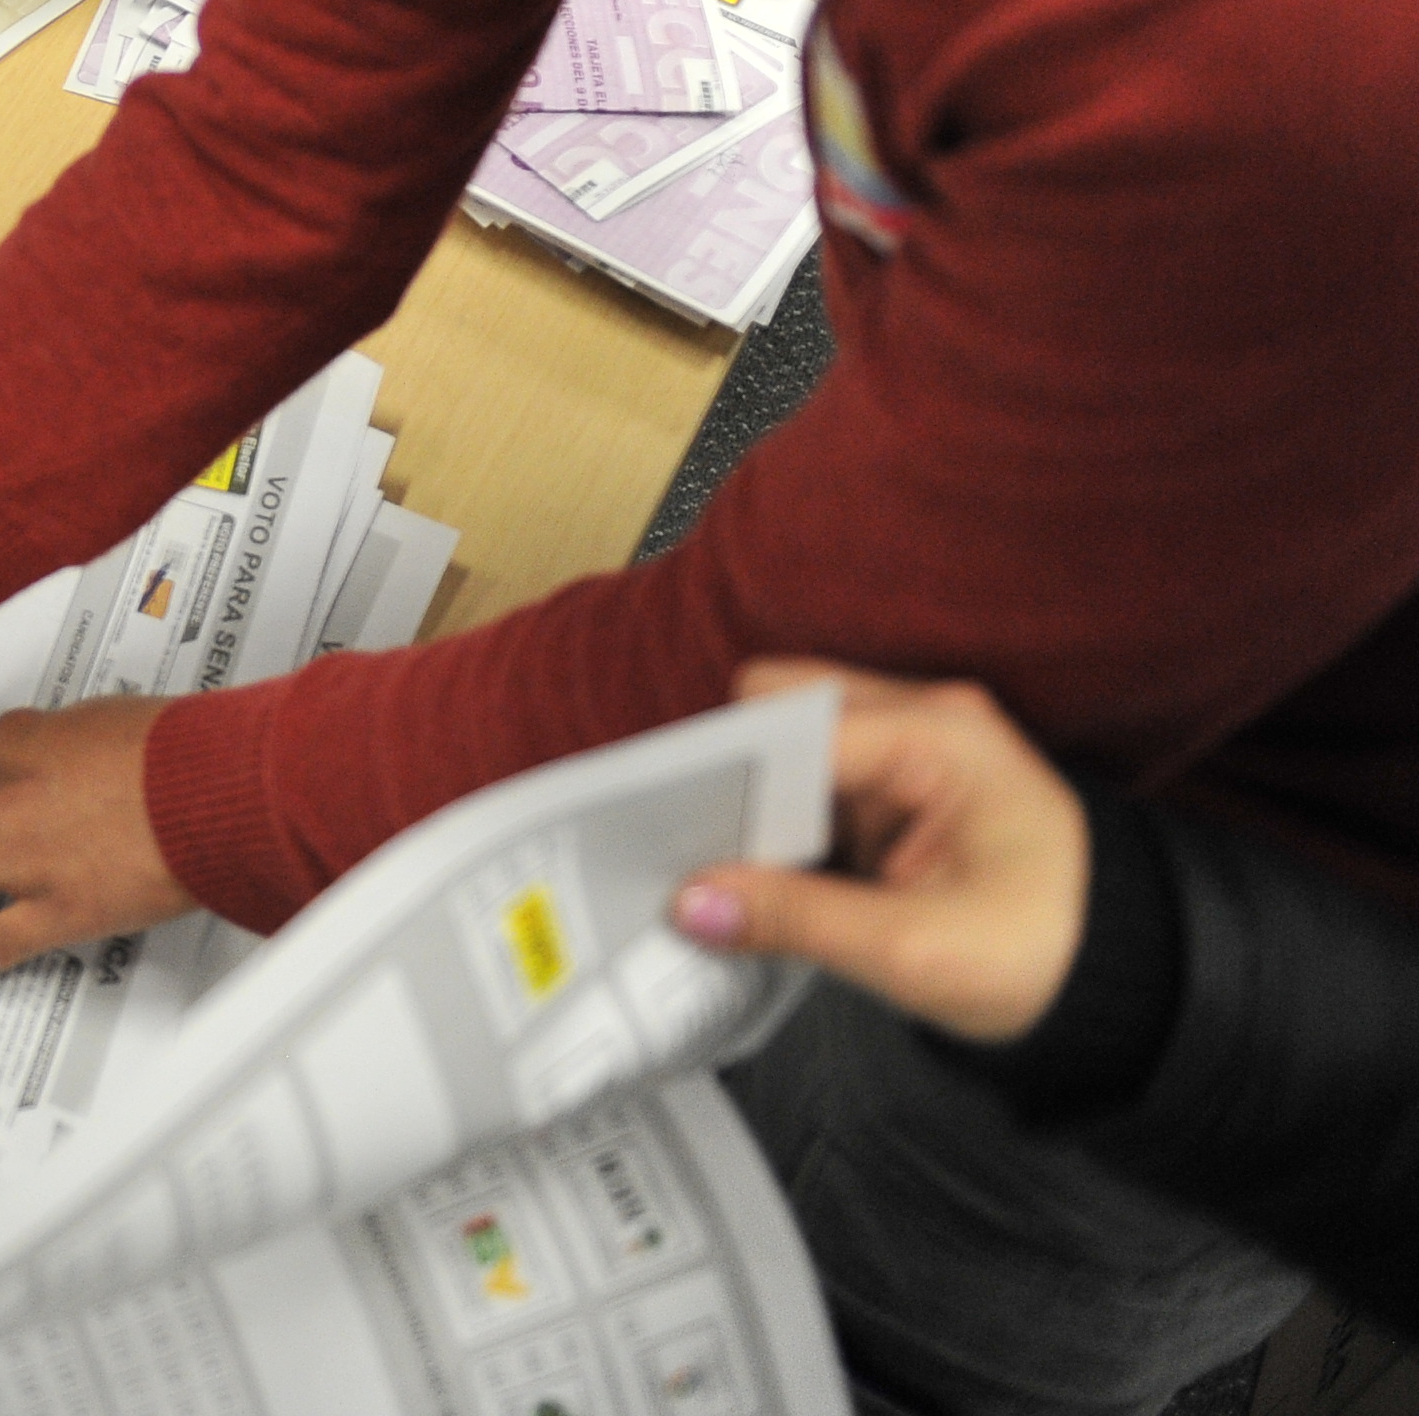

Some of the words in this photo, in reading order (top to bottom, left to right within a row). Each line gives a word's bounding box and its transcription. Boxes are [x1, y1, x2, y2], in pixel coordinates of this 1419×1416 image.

[586, 39, 604, 87] TARJETA
[250, 475, 289, 545] VOTO
[221, 551, 262, 623] PARA
